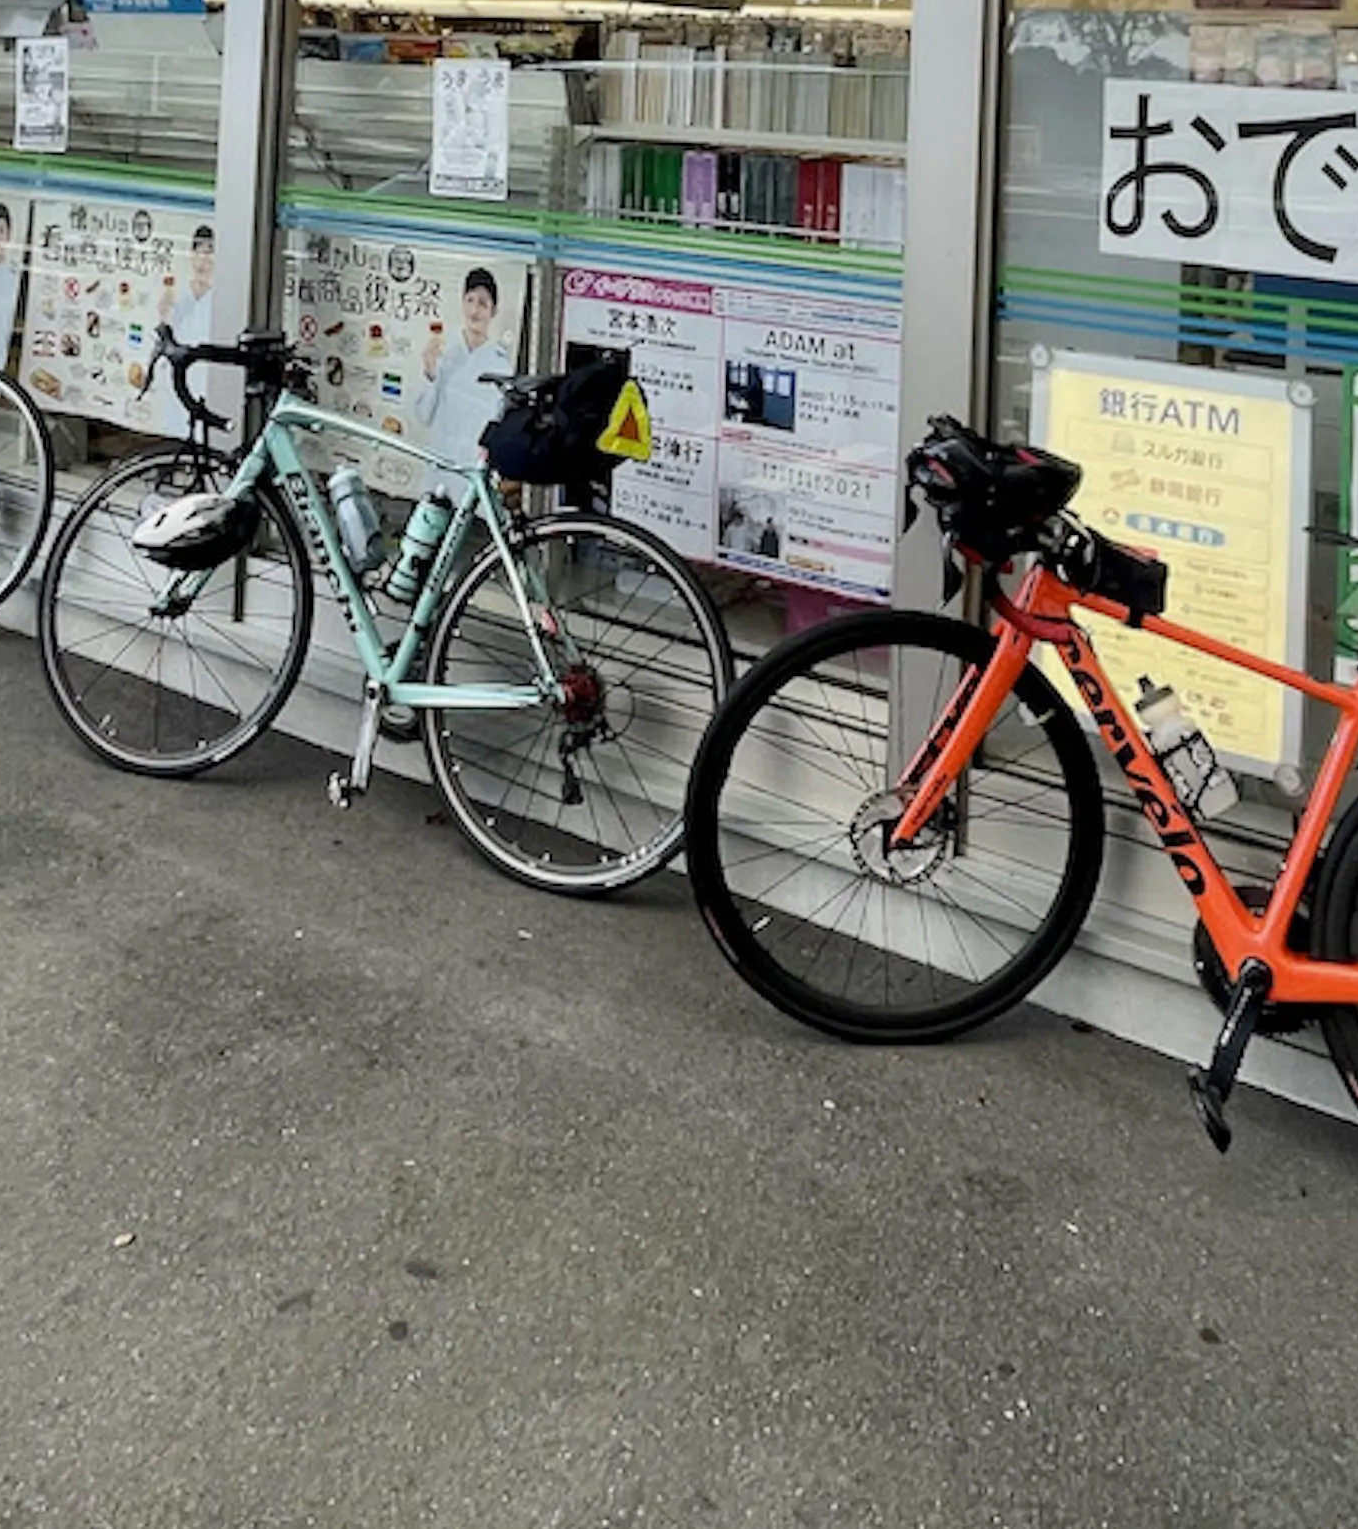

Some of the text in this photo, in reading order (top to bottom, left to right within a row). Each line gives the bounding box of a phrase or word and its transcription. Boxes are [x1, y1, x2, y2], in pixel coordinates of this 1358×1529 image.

[765, 330, 855, 361] ADAM at
[1099, 388, 1240, 435] 銀行ATM
